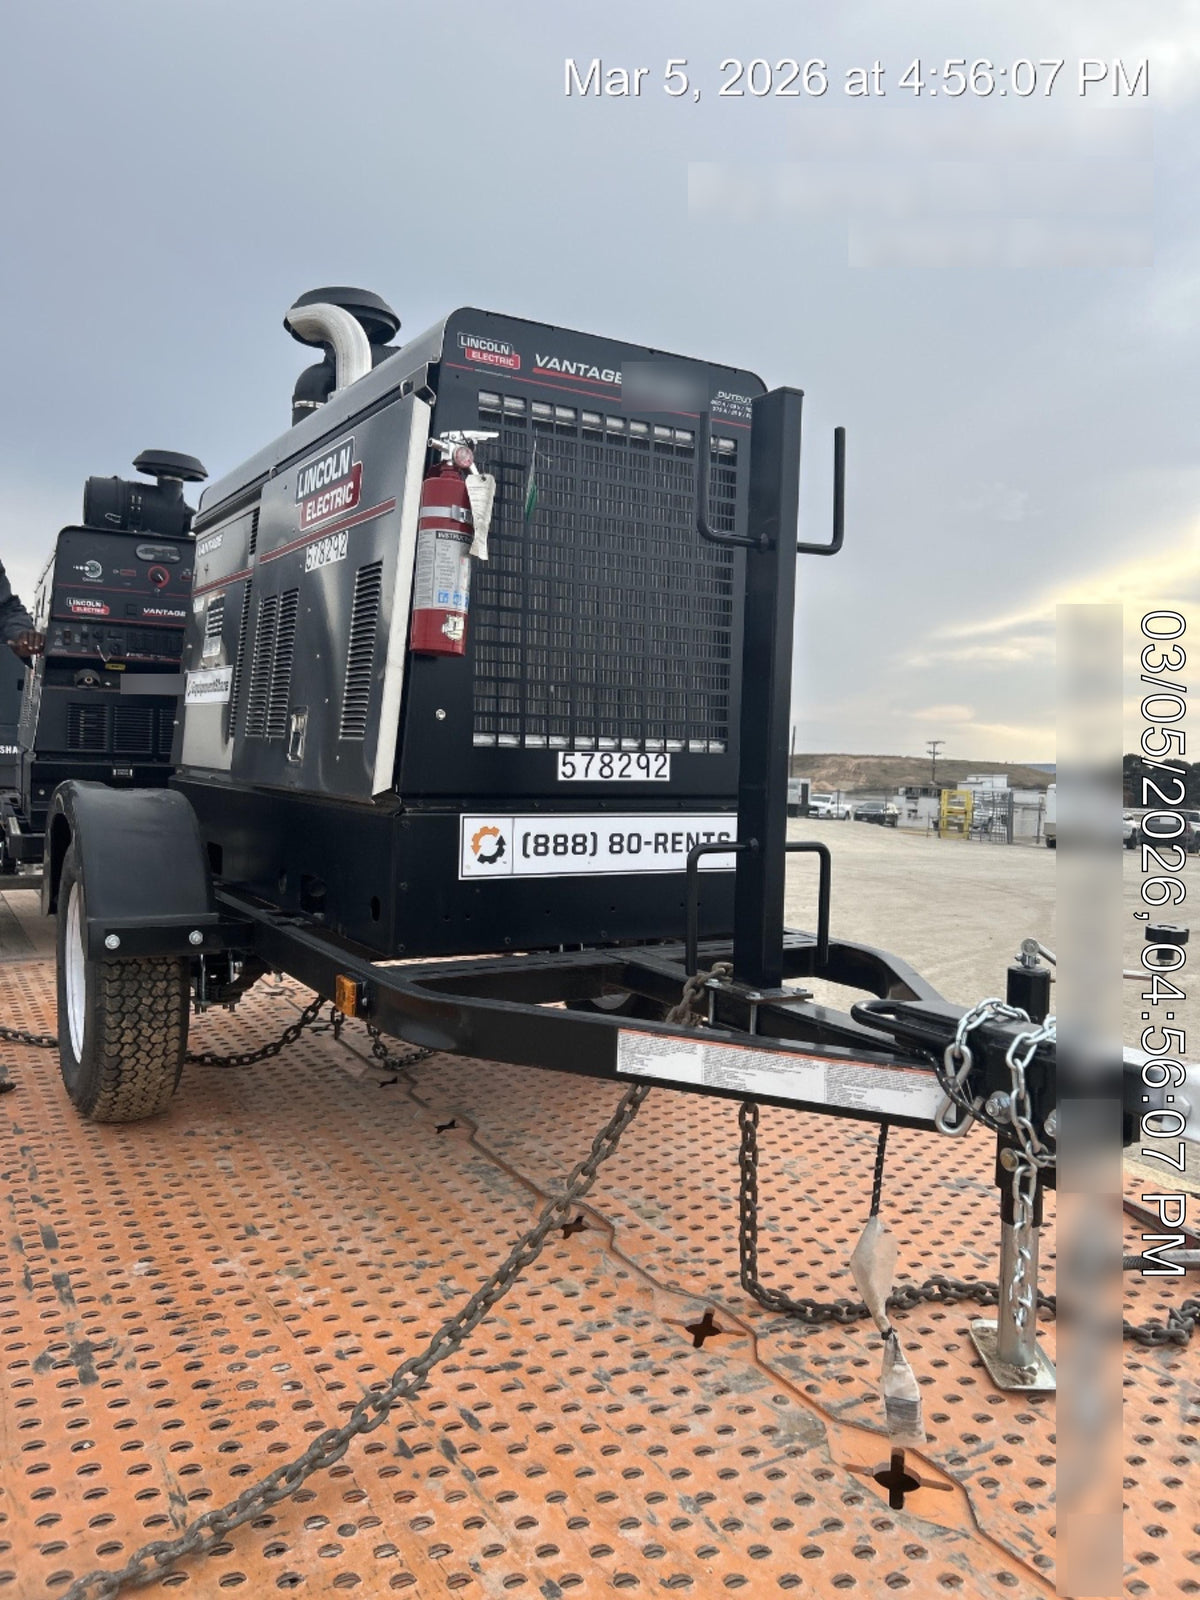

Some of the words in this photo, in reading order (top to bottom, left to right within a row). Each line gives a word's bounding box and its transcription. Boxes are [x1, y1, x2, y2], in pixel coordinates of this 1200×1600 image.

[460, 335, 510, 355] LINCOLN
[471, 350, 515, 367] ELECTRIC
[534, 353, 623, 385] VANTAGE
[297, 446, 352, 499] LINCOLN
[305, 480, 354, 522] ELECTRIC
[68, 598, 103, 608] LINCOLN
[143, 607, 187, 618] VANTAGE
[560, 753, 668, 779] 578292
[521, 831, 599, 858] (888)
[607, 831, 730, 855] 80-RENTS
